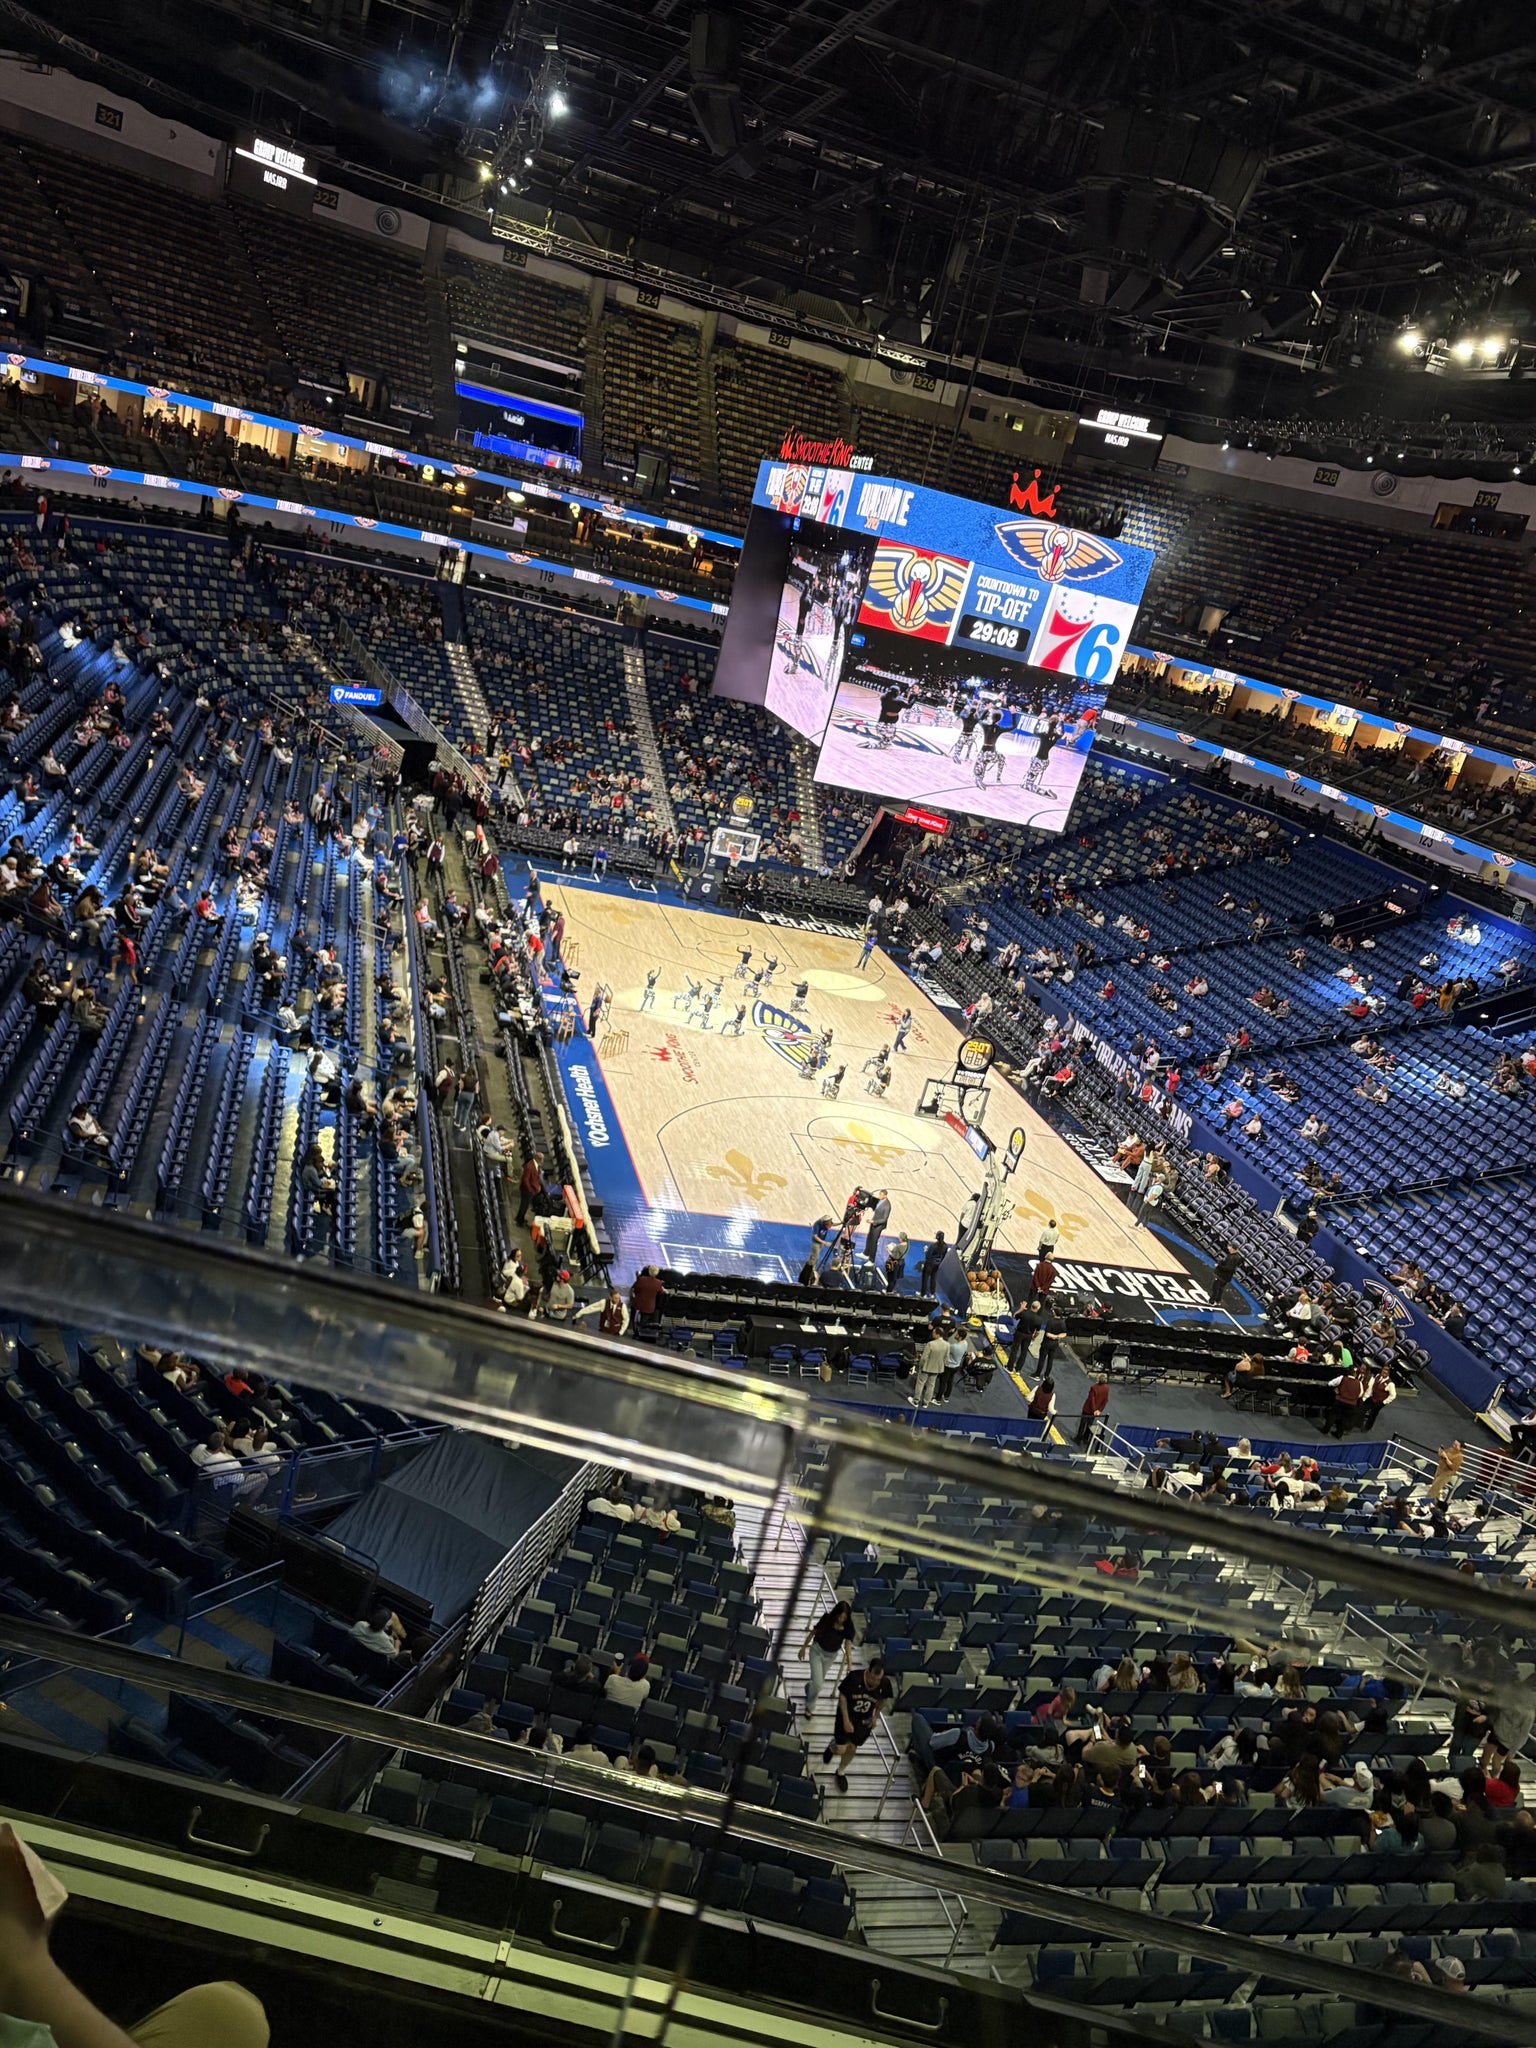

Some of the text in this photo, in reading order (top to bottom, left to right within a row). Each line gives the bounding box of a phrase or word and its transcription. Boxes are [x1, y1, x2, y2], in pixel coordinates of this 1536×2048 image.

[99, 109, 121, 128] 321
[504, 251, 526, 265] 323
[638, 292, 659, 306] 324
[769, 332, 790, 348] 325
[914, 376, 935, 391] 326
[850, 455, 874, 471] CENTER
[1315, 470, 1338, 484] 328
[1475, 493, 1499, 507] 329
[977, 575, 1040, 602] COUNTDOWN TO
[975, 590, 1033, 623] TIP-OFF
[969, 620, 1020, 649] 29:08
[344, 691, 377, 702] FANDUEL
[758, 910, 867, 941] PELICANS
[853, 1700, 872, 1714] 23
